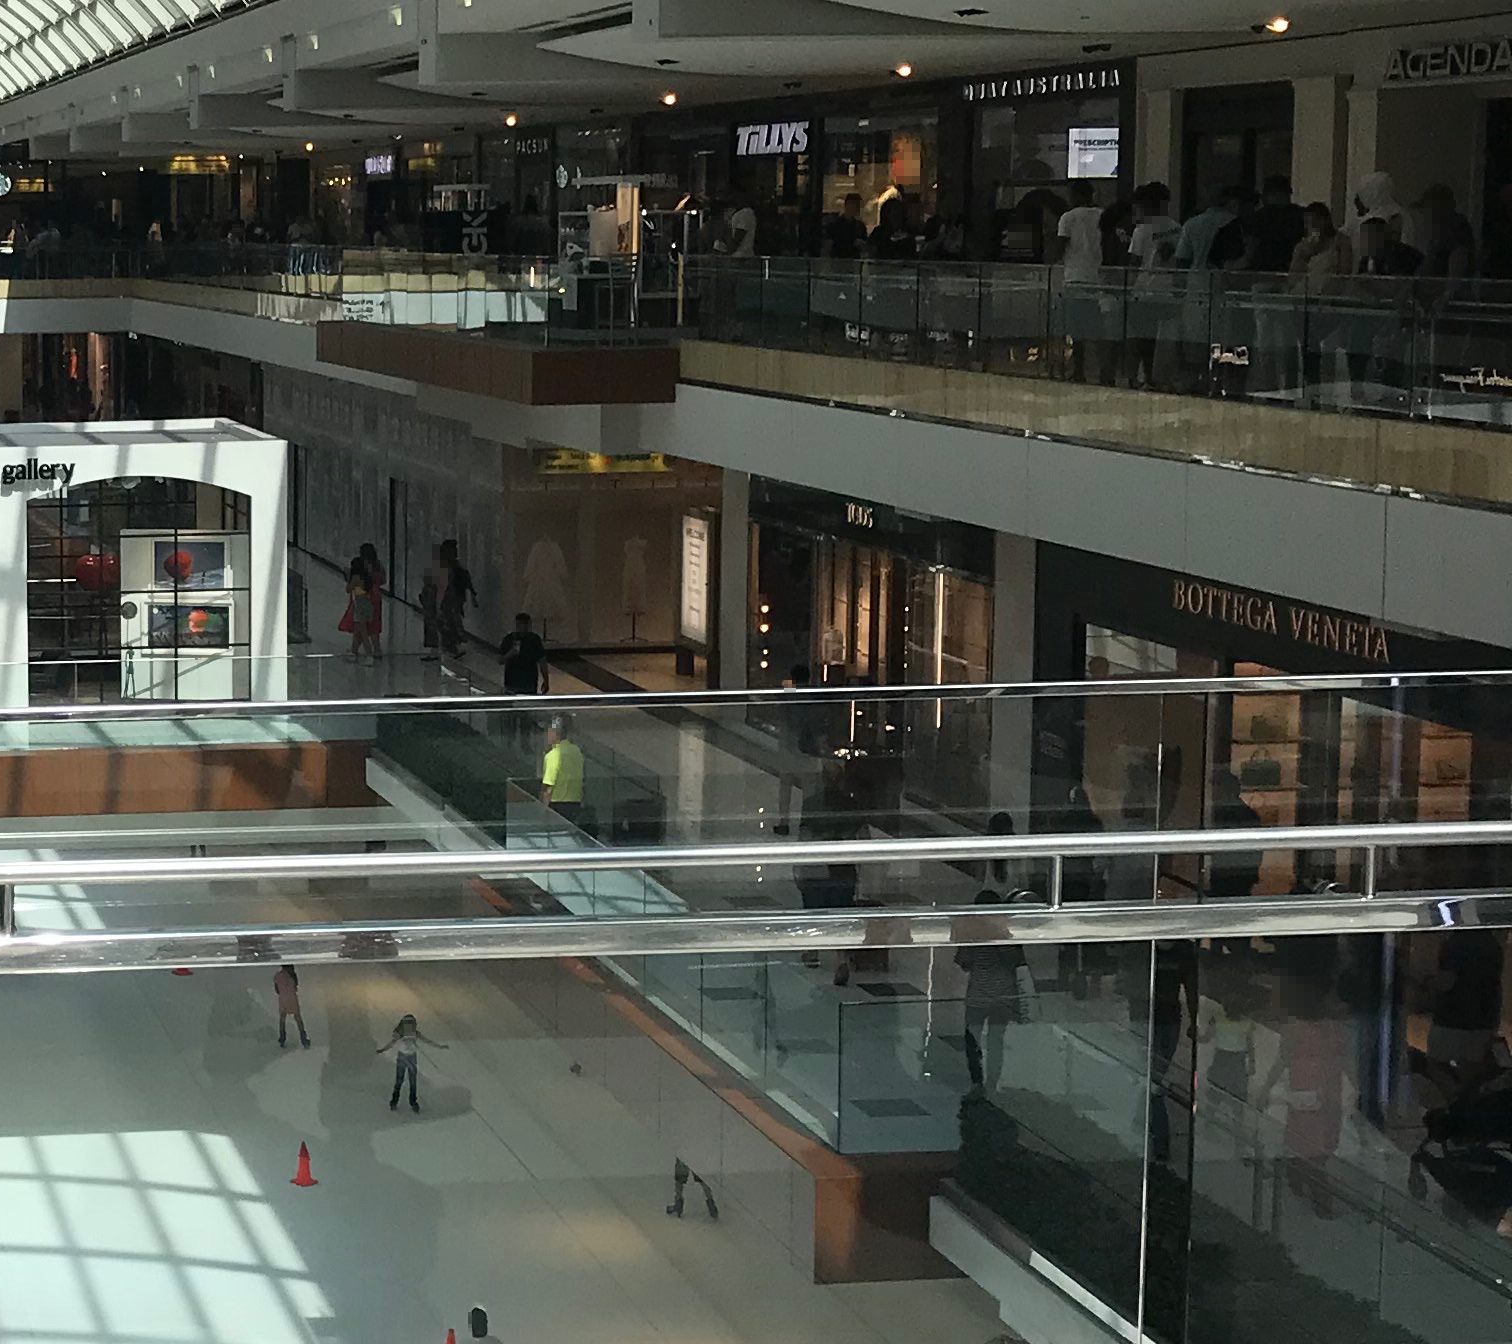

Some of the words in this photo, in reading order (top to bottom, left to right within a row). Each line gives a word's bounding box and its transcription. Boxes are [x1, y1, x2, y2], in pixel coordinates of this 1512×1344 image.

[1384, 36, 1512, 80] AGENDA
[1012, 68, 1120, 96] AUSTRALIA
[2, 458, 76, 486] gallery
[1172, 578, 1278, 636] BOTTEGA
[1289, 605, 1391, 665] VENETA
